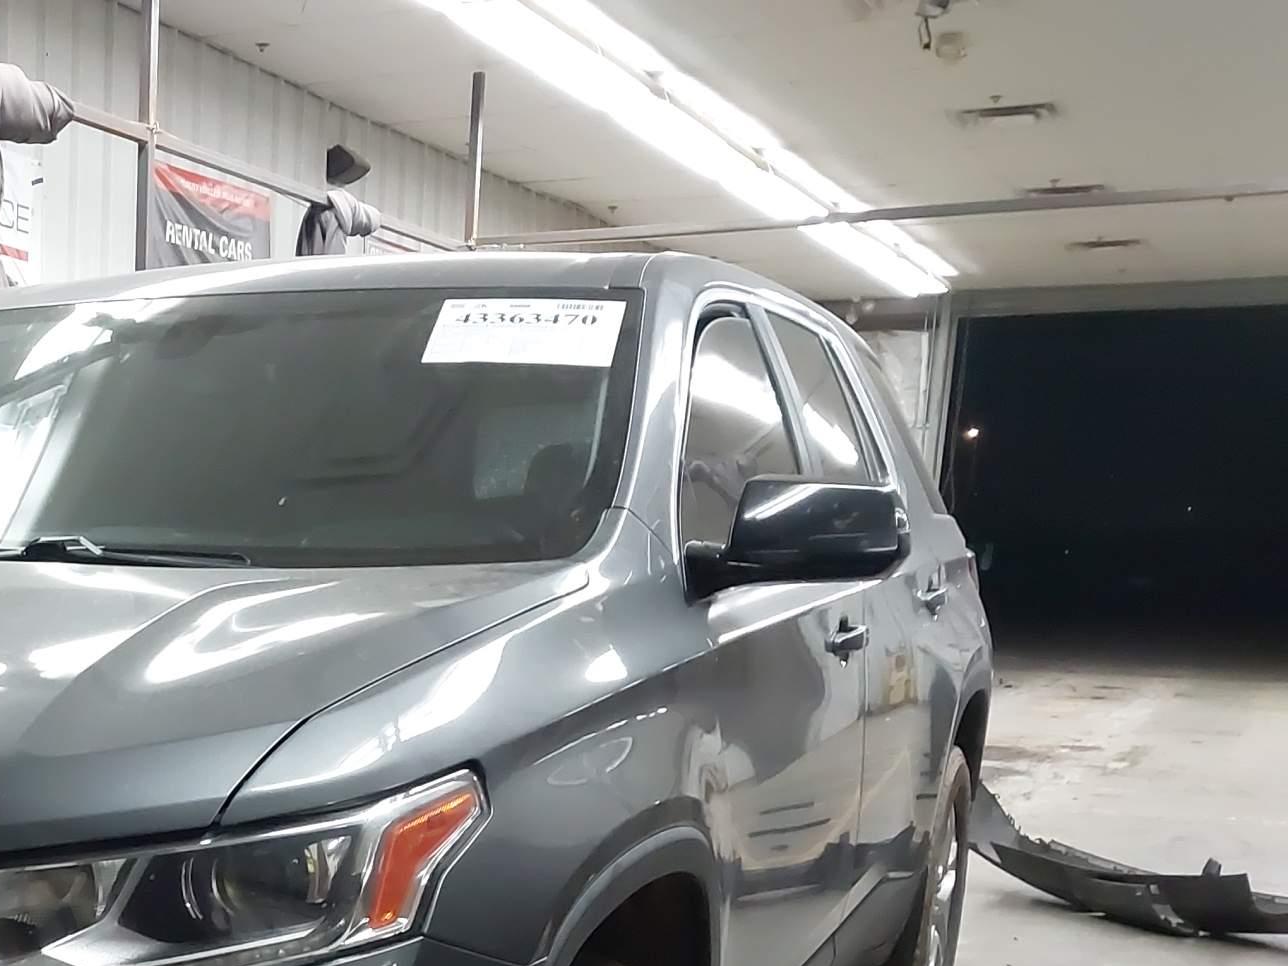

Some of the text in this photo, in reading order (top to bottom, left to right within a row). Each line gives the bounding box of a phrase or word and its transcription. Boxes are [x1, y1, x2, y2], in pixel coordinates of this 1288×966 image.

[165, 219, 253, 262] RENTAL CARS
[455, 312, 599, 326] 43363470
